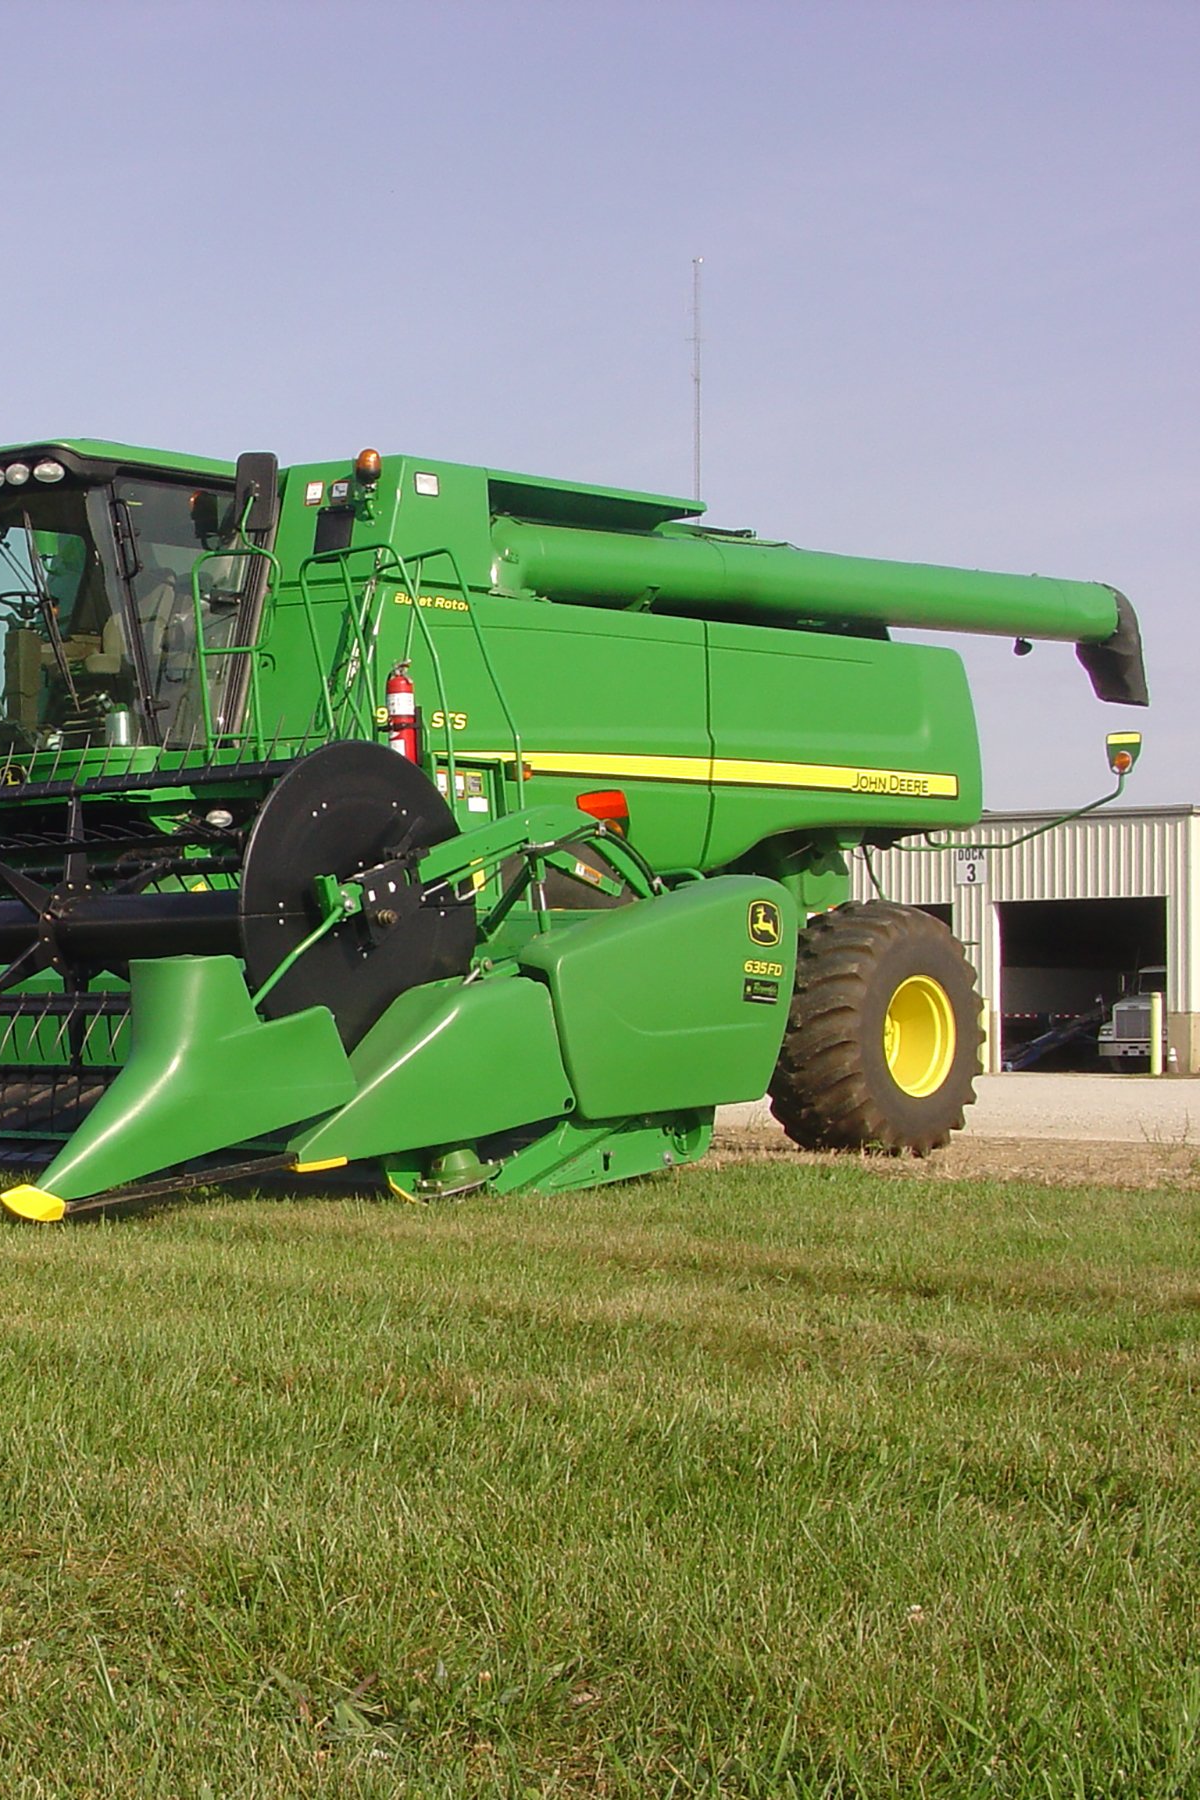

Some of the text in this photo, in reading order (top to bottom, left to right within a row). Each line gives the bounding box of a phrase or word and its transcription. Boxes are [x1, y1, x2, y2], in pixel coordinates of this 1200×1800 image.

[394, 592, 433, 607] Buet
[852, 772, 929, 793] JOHN DEERE
[958, 848, 985, 861] DOCK
[966, 863, 976, 882] 3
[744, 960, 783, 976] 635FD
